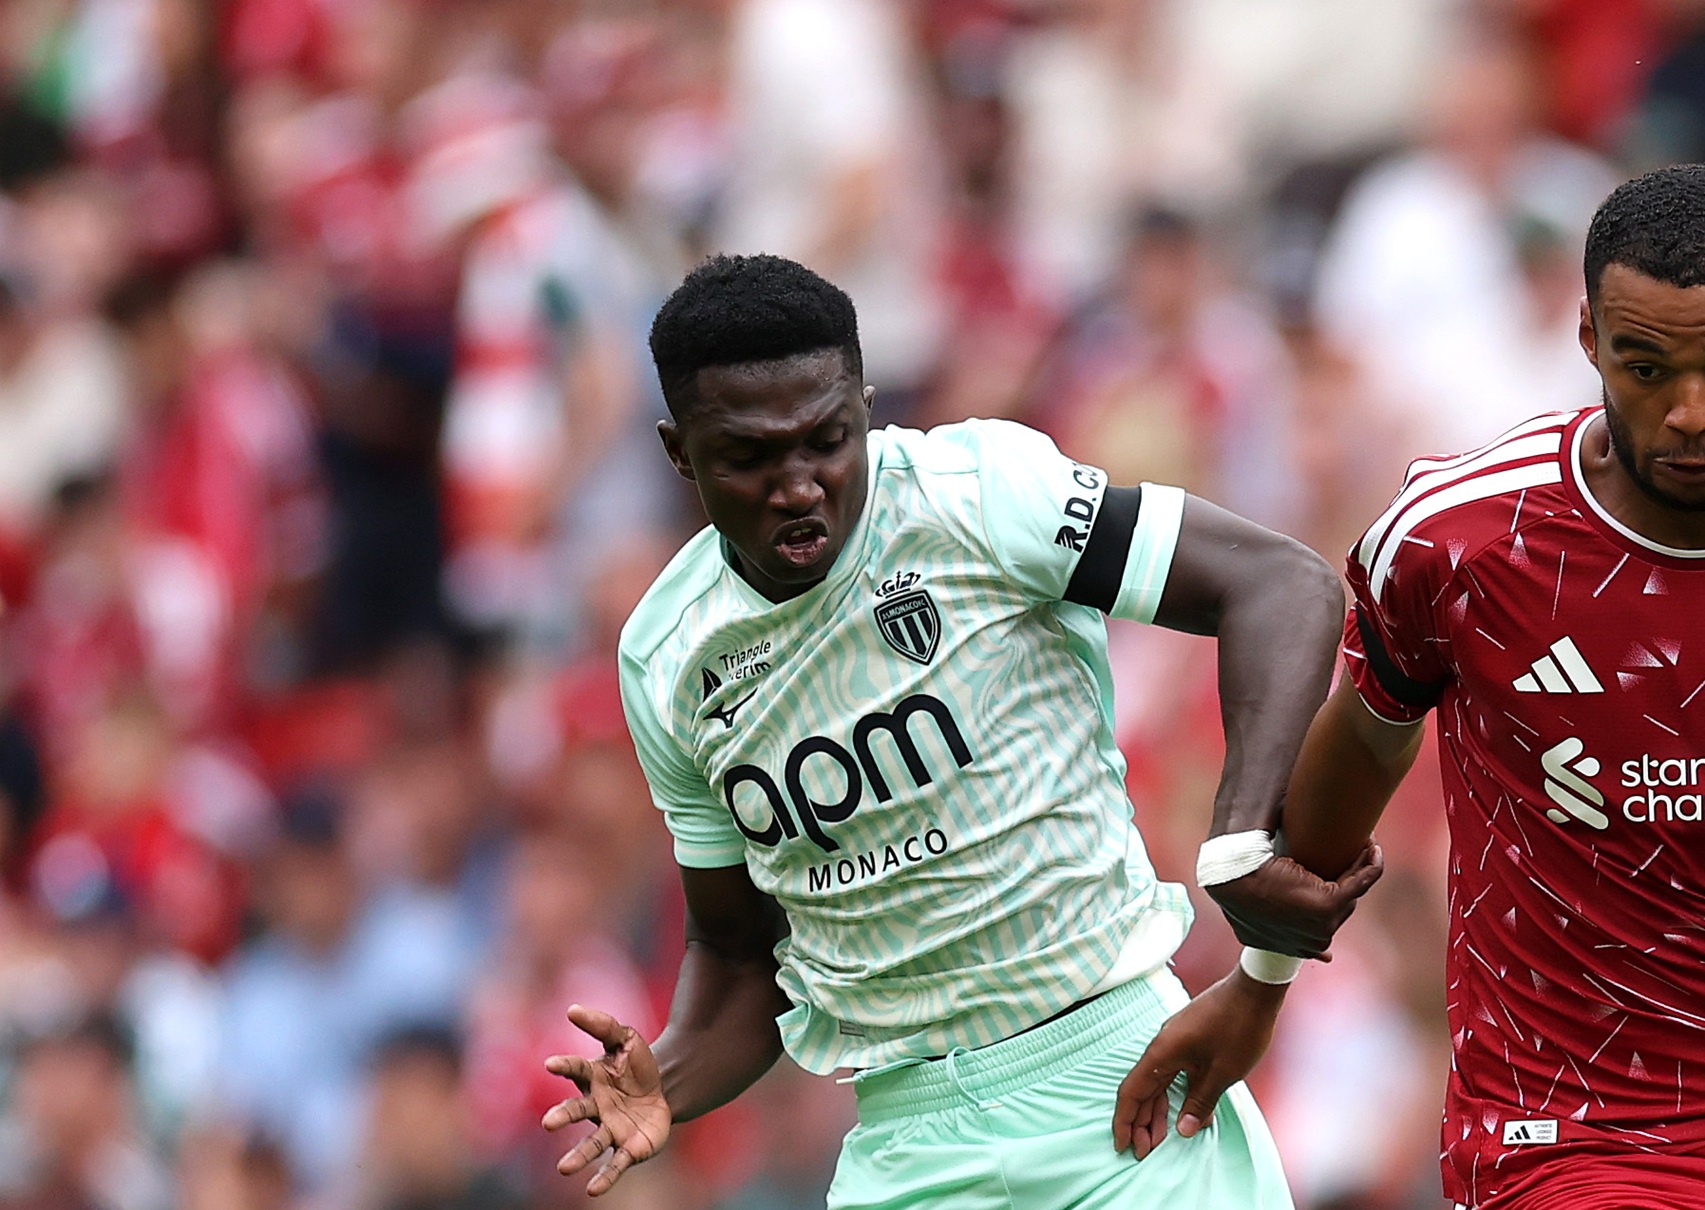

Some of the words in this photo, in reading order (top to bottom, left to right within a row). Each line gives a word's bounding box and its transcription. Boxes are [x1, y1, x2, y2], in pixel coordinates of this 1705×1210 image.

[719, 640, 771, 671] Triangle
[724, 694, 973, 853] apm
[808, 828, 948, 892] MONACO
